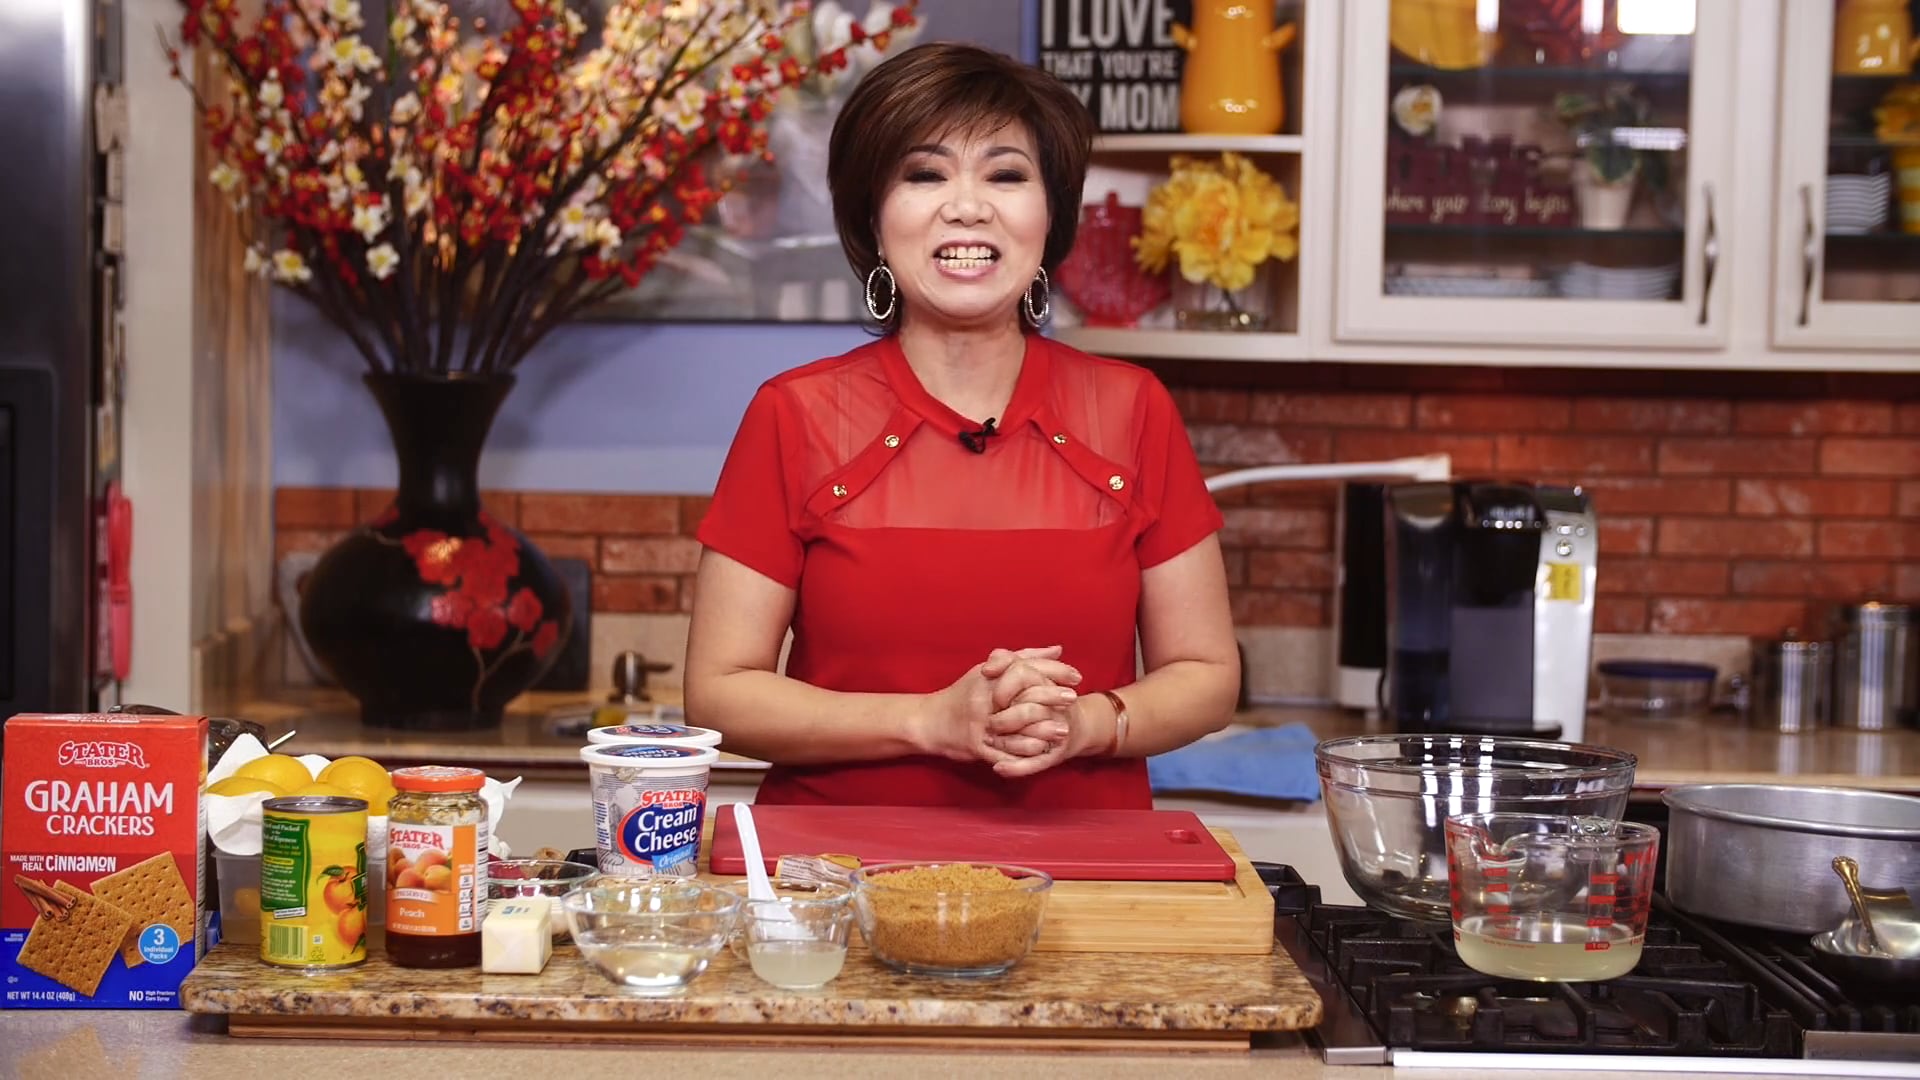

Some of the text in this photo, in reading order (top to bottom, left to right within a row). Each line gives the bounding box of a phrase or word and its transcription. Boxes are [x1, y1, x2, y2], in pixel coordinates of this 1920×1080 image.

[1042, 0, 1176, 47] I LOVE
[1043, 52, 1177, 79] THAT YOU'RE
[1101, 83, 1180, 130] MOM
[1430, 196, 1468, 224] your
[58, 741, 146, 769] STATER
[25, 780, 174, 814] GRAHAM
[640, 789, 704, 809] STATER
[46, 815, 155, 836] CRACKERS
[637, 807, 697, 832] Cream
[390, 828, 445, 850] STATER
[634, 826, 697, 853] Cheese
[22, 862, 44, 871] REAL
[153, 928, 165, 945] 3
[7, 991, 19, 1000] NET
[20, 991, 30, 1000] WT
[129, 990, 144, 1001] NO
